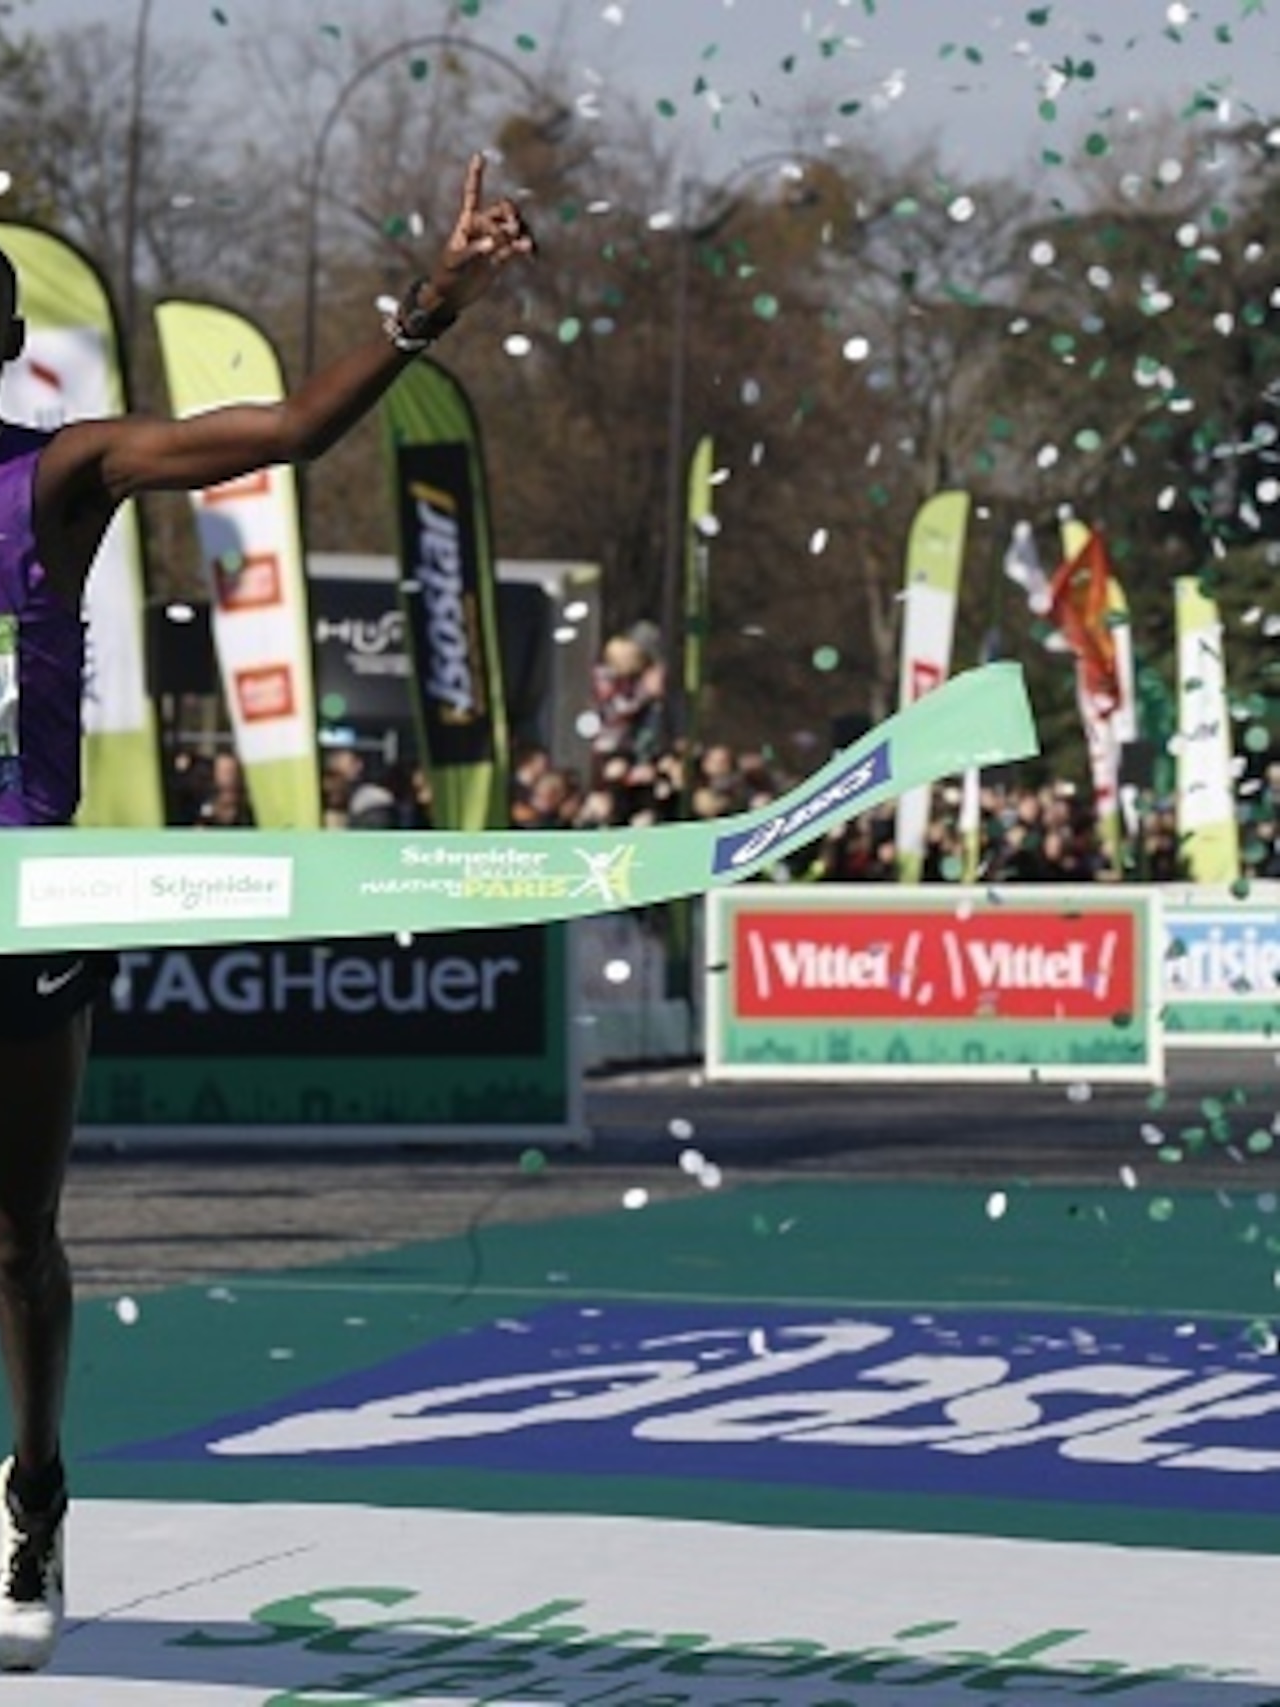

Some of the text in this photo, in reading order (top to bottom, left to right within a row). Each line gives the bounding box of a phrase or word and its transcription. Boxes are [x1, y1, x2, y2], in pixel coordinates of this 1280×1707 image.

[150, 874, 279, 902] Schneider
[772, 941, 890, 988] Vittel
[967, 941, 1086, 988] Vittel
